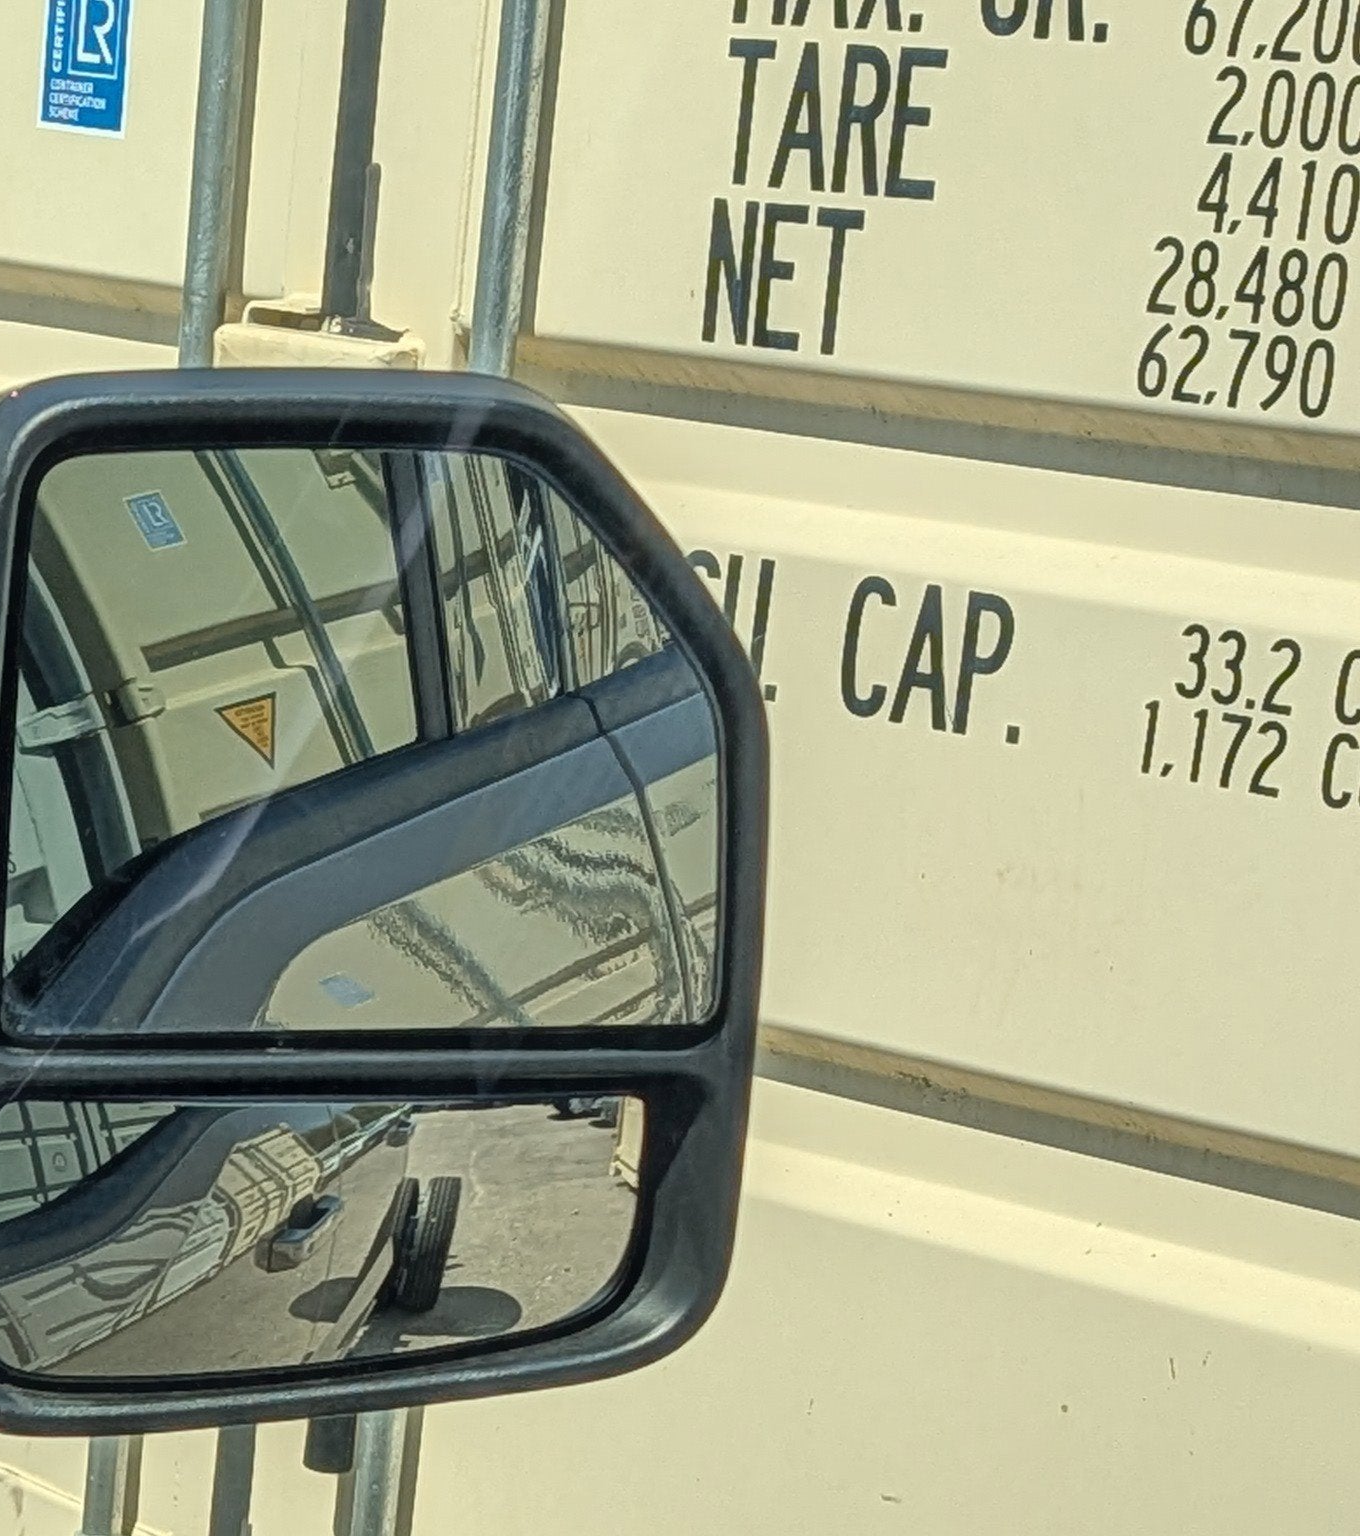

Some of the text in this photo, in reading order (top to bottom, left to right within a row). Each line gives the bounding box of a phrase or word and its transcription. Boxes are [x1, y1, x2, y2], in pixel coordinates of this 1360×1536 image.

[1185, 0, 1360, 66] 67,20
[729, 38, 948, 200] TARE
[1206, 65, 1360, 155] 2,000
[1197, 152, 1360, 245] 4,410
[701, 197, 866, 355] NET
[1146, 236, 1348, 331] 28,480
[1137, 322, 1335, 418] 62,790
[684, 549, 1020, 745] U. CAP.
[1174, 623, 1301, 717] 33.2
[1141, 700, 1360, 809] 1,172 C
